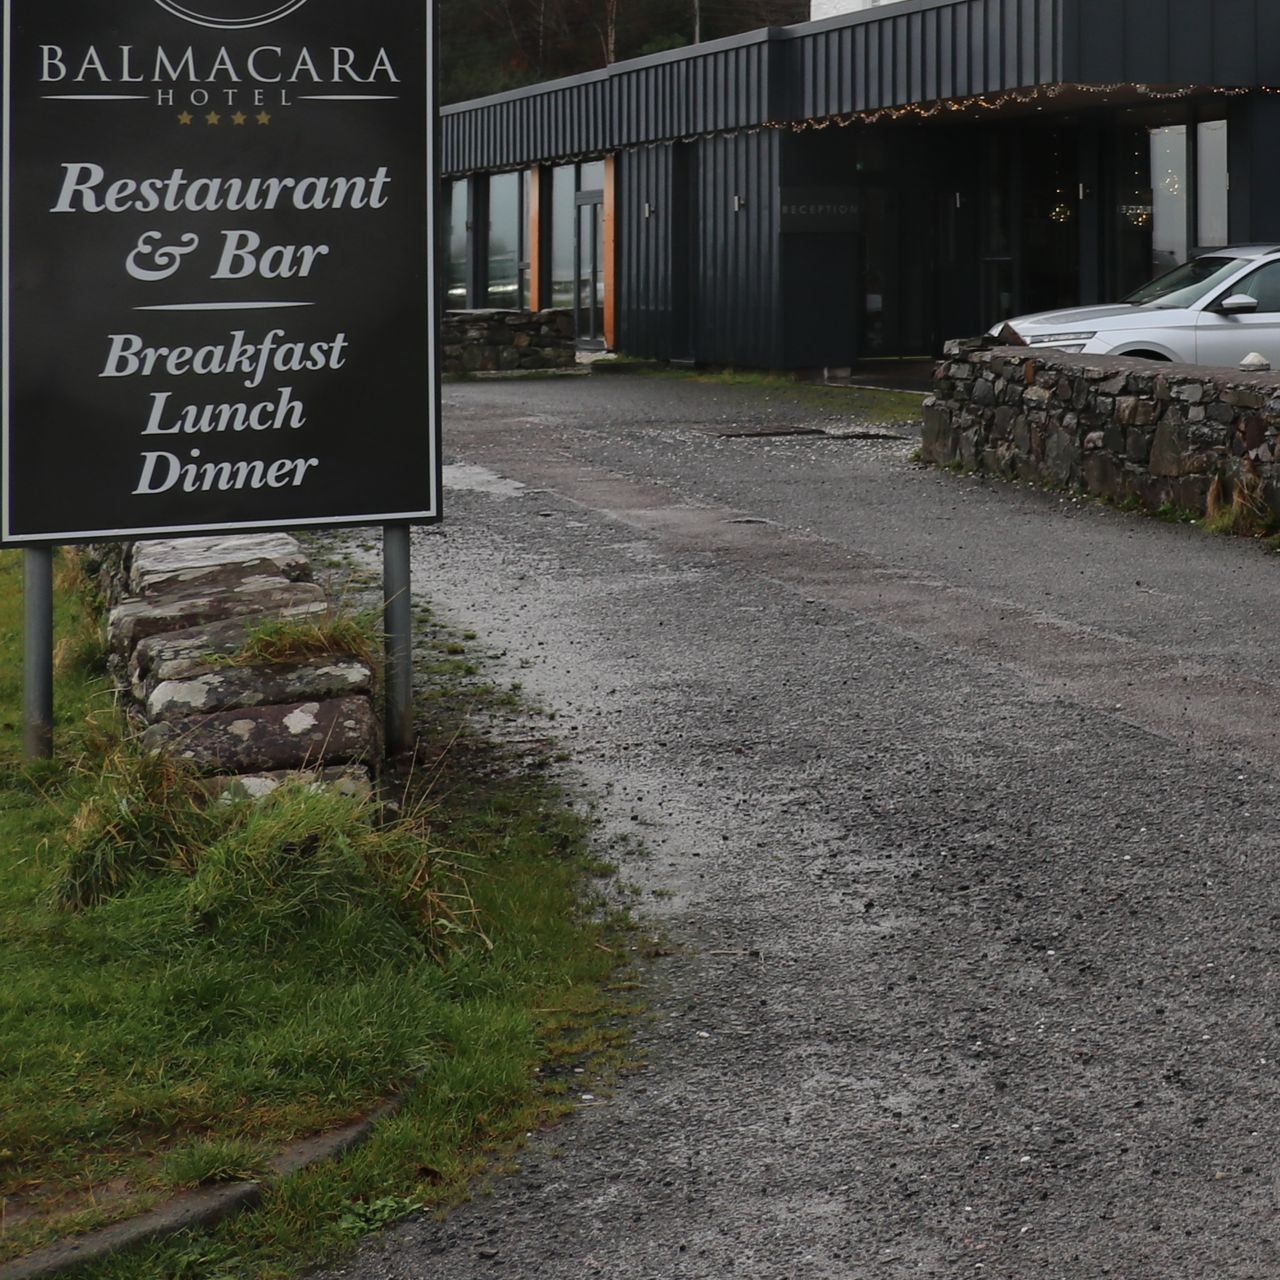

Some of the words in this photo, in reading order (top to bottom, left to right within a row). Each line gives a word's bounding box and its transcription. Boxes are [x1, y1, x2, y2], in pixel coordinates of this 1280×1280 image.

[39, 45, 400, 83] BALMACARA
[157, 88, 292, 107] HOTEL
[50, 162, 392, 214] Restaurant
[782, 204, 860, 215] RECEPTION
[125, 231, 199, 281] &
[211, 230, 329, 279] Bar
[99, 329, 348, 390] Breakfast
[141, 386, 306, 435] Lunch
[132, 448, 319, 495] Dinner
